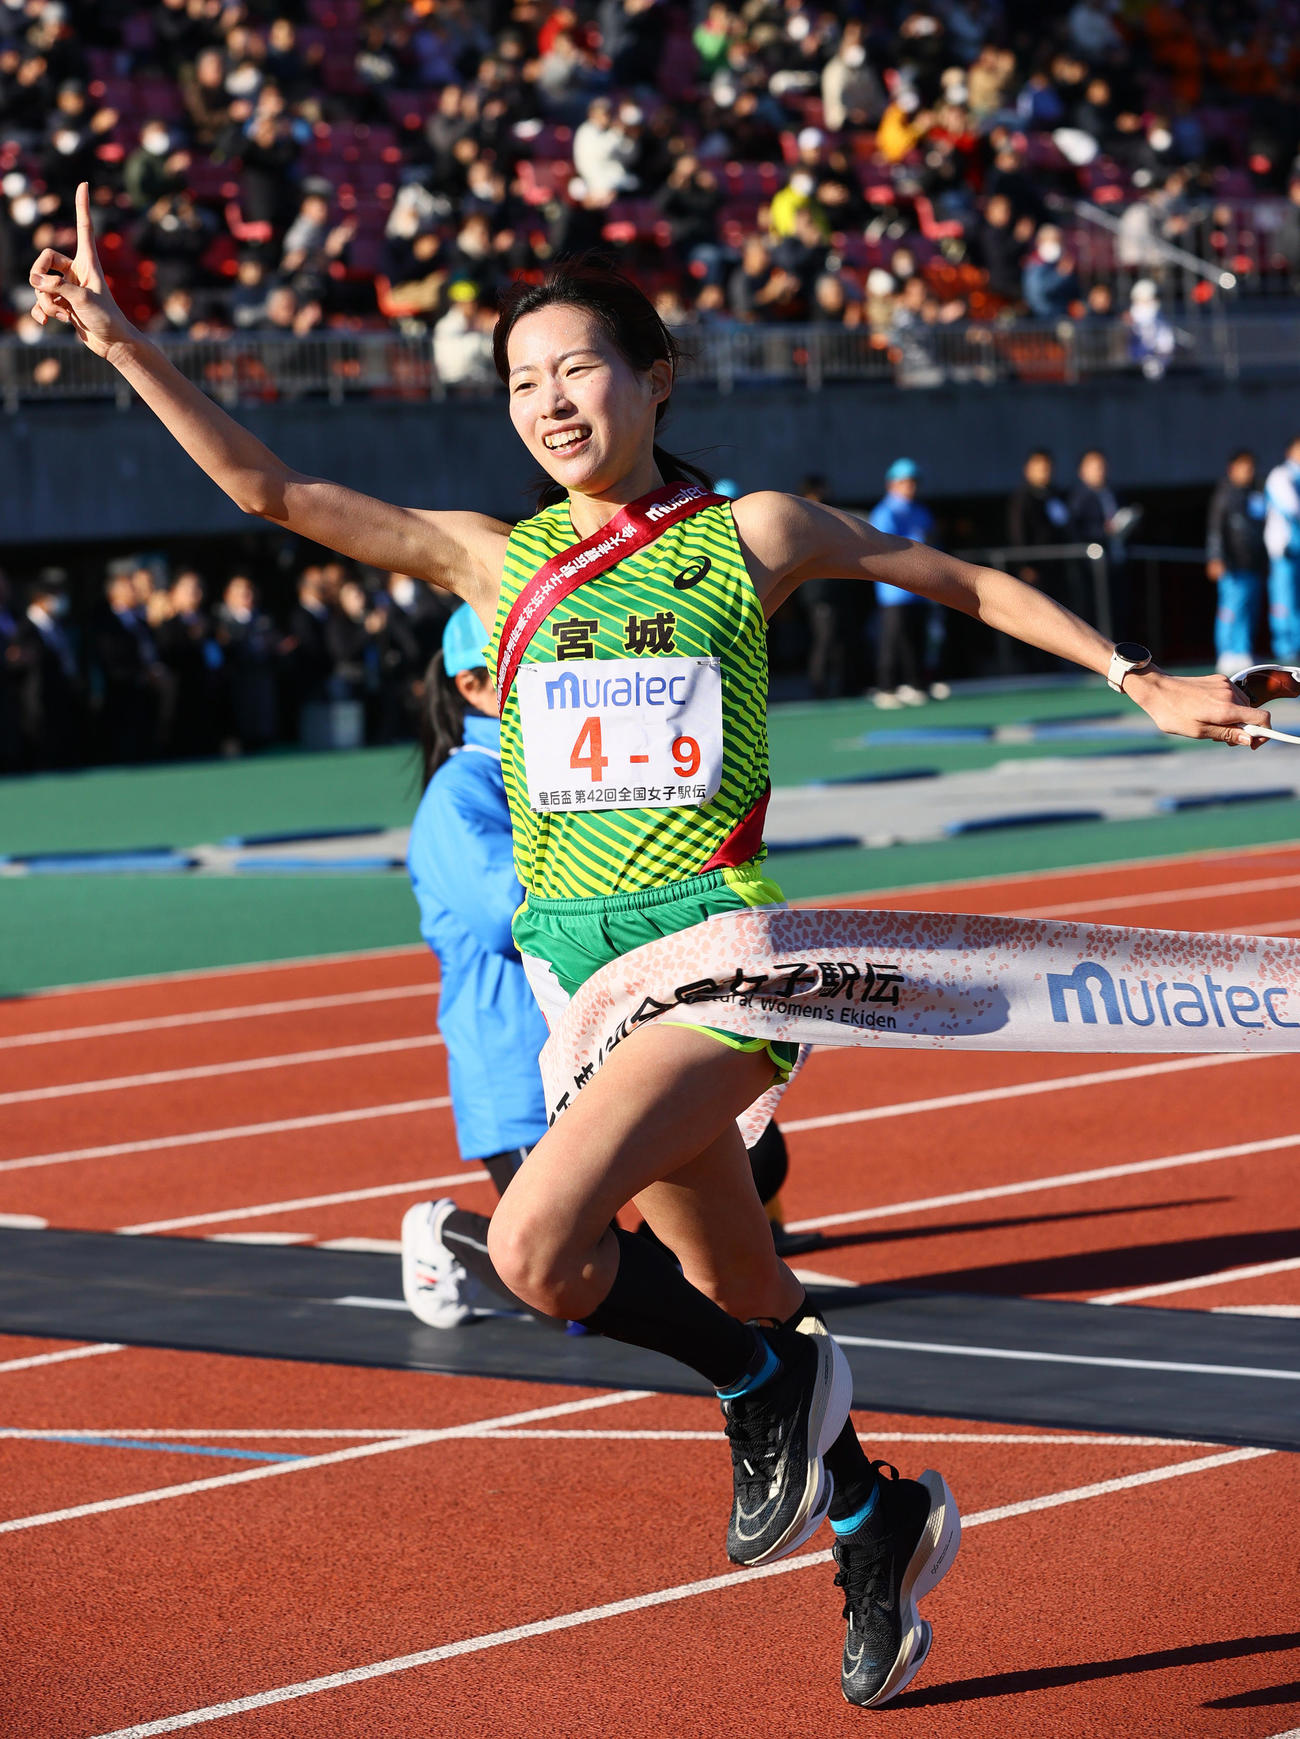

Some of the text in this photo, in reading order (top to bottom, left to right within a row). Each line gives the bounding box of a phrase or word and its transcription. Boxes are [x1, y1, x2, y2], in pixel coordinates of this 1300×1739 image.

[552, 611, 677, 661] 宮城
[539, 784, 707, 806] 皇后盃 第42回全国女子駅伝
[760, 996, 834, 1022] Women's
[840, 1007, 897, 1030] Ekiden
